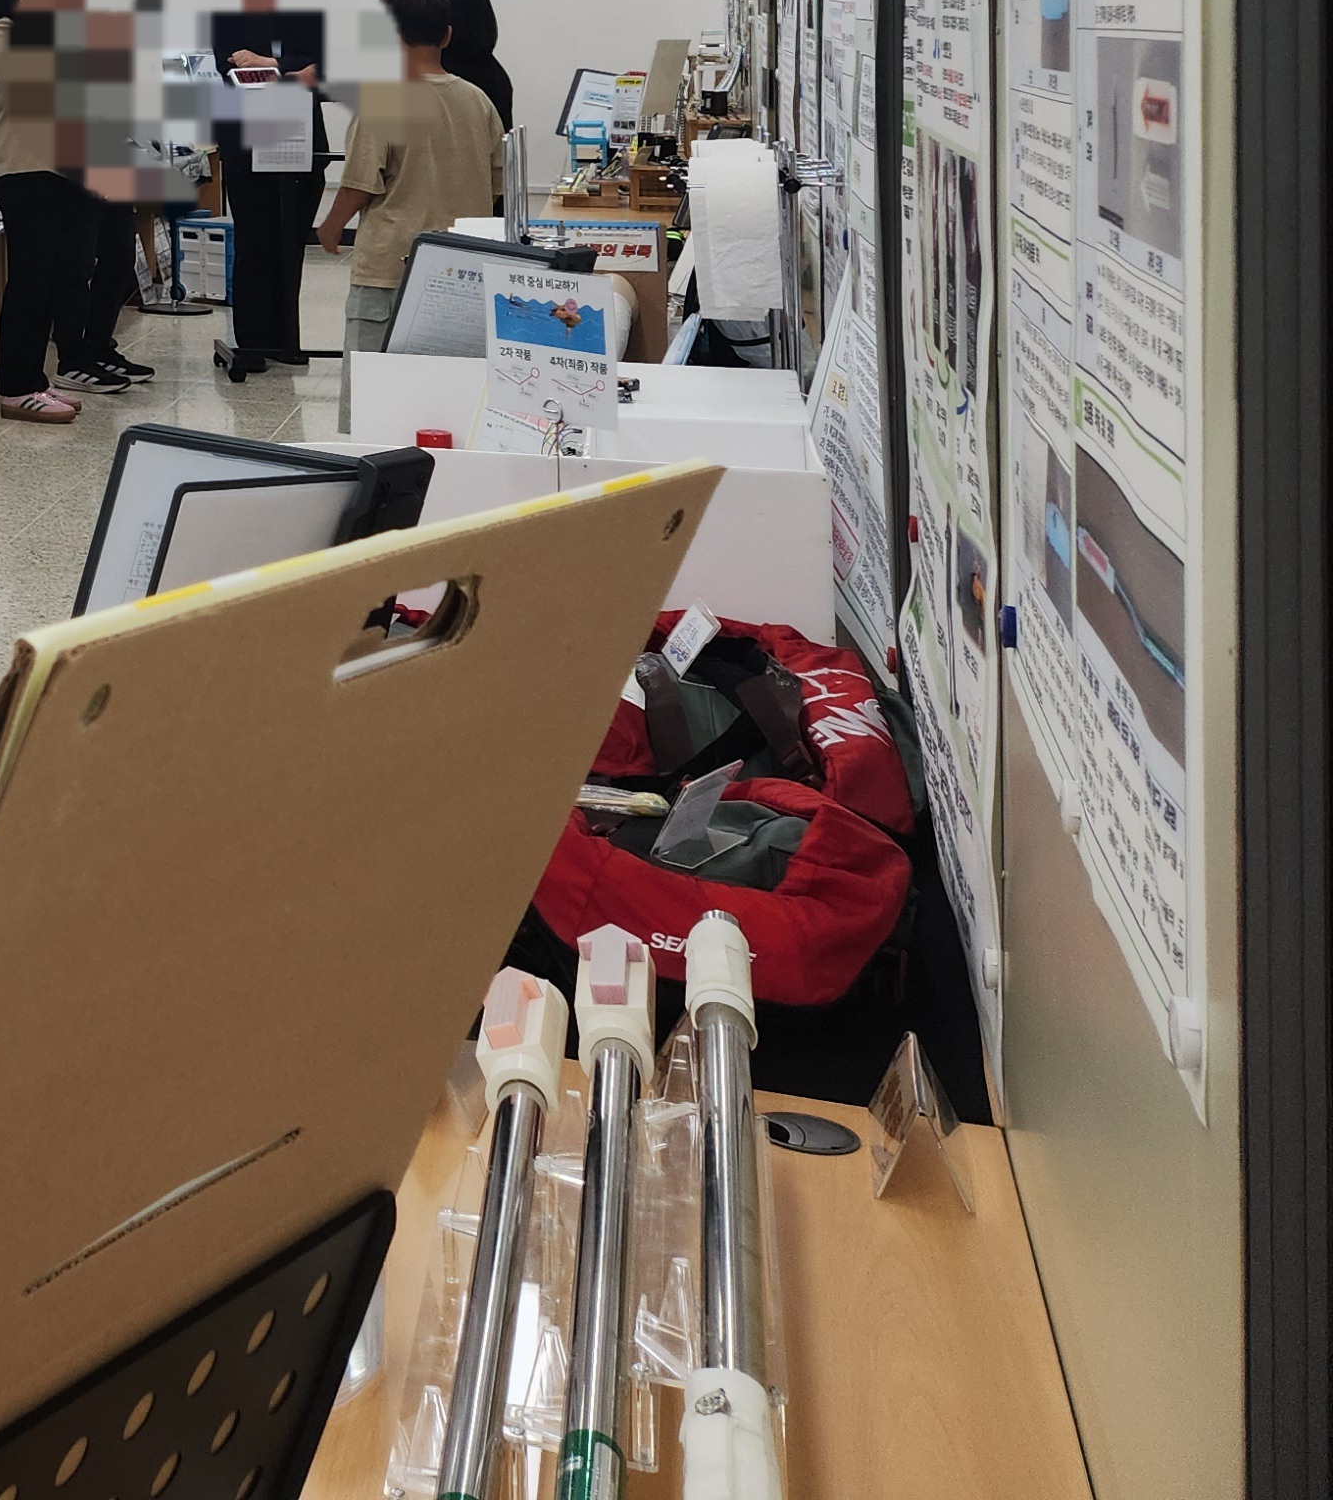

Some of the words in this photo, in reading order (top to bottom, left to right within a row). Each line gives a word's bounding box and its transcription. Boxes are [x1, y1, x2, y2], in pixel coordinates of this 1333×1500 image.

[508, 273, 526, 286] 부력
[527, 274, 544, 289] 중심
[545, 277, 580, 293] 비교하기
[499, 347, 514, 359] 2차
[515, 347, 532, 362] 작품
[549, 356, 589, 374] 4차(최종)
[590, 362, 608, 376] 작품
